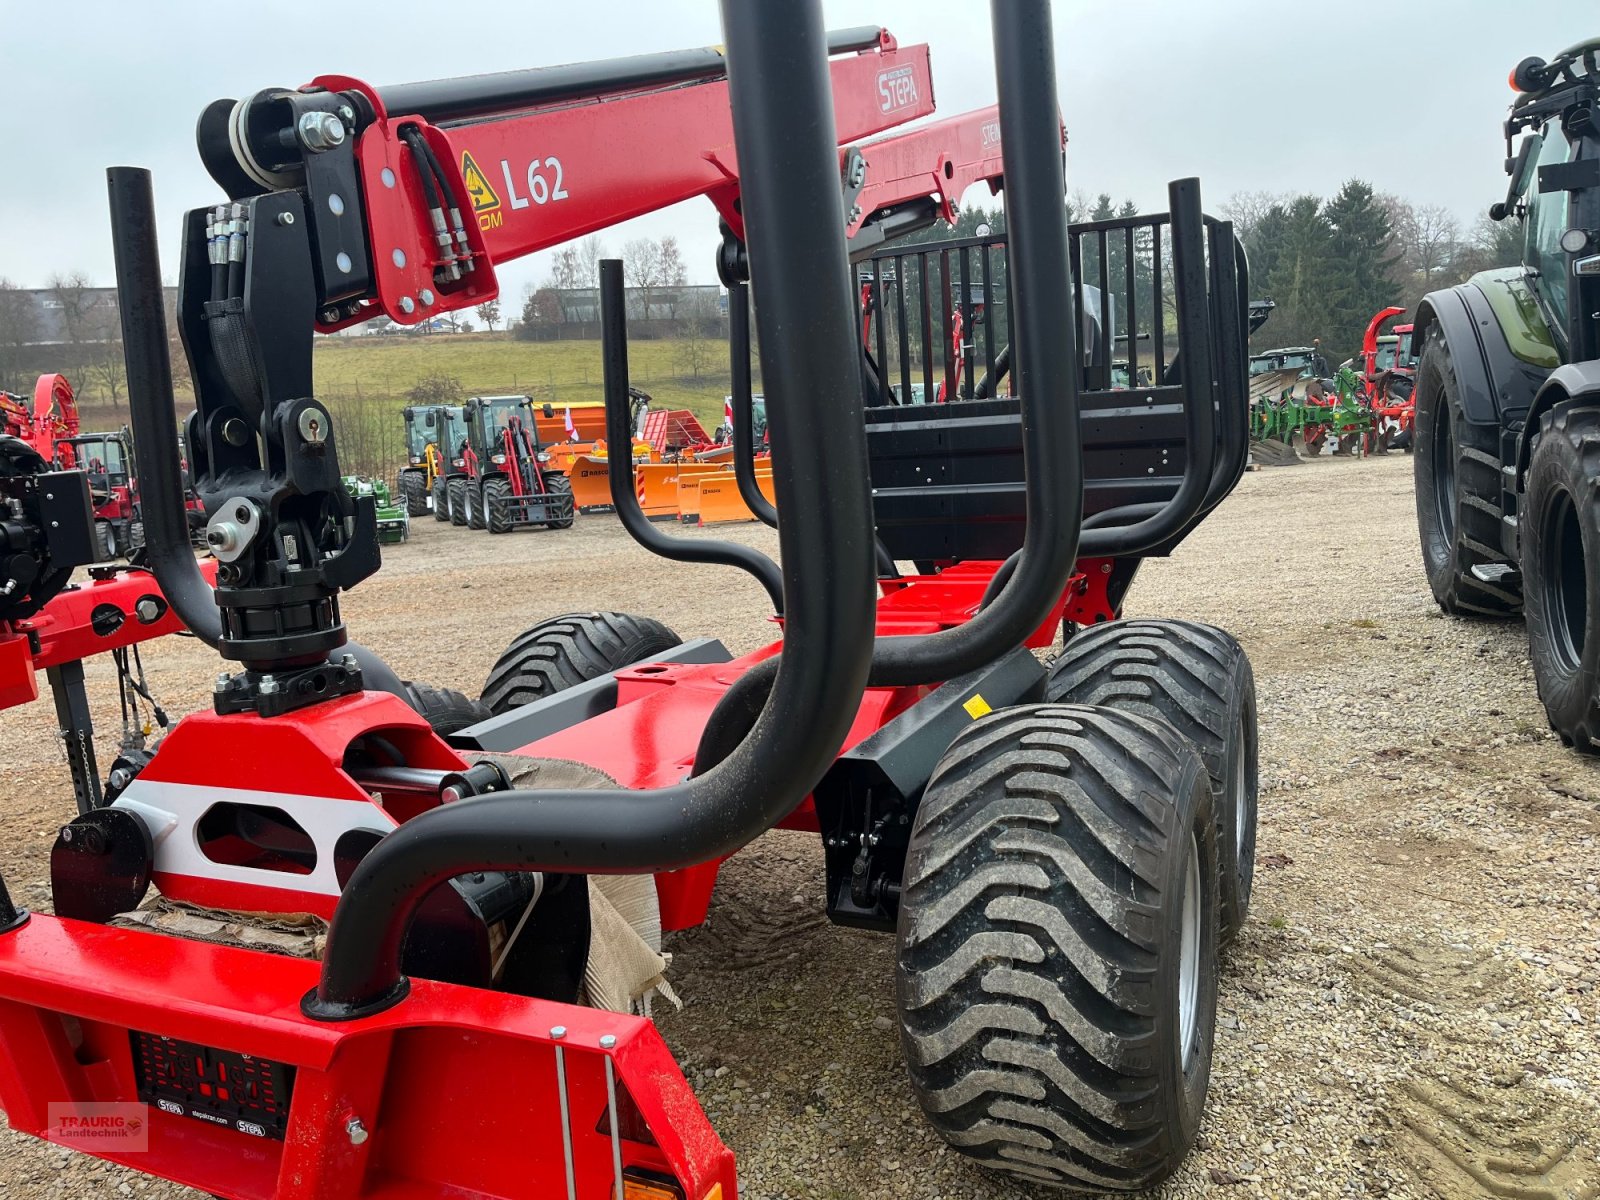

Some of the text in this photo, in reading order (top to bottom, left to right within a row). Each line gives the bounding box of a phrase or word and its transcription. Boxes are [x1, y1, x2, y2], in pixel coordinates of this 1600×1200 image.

[878, 73, 918, 111] STEPA
[500, 156, 569, 210] L62
[159, 1100, 182, 1114] STEPA
[191, 1110, 228, 1125] stepakran.com
[238, 1121, 263, 1136] STEPA
